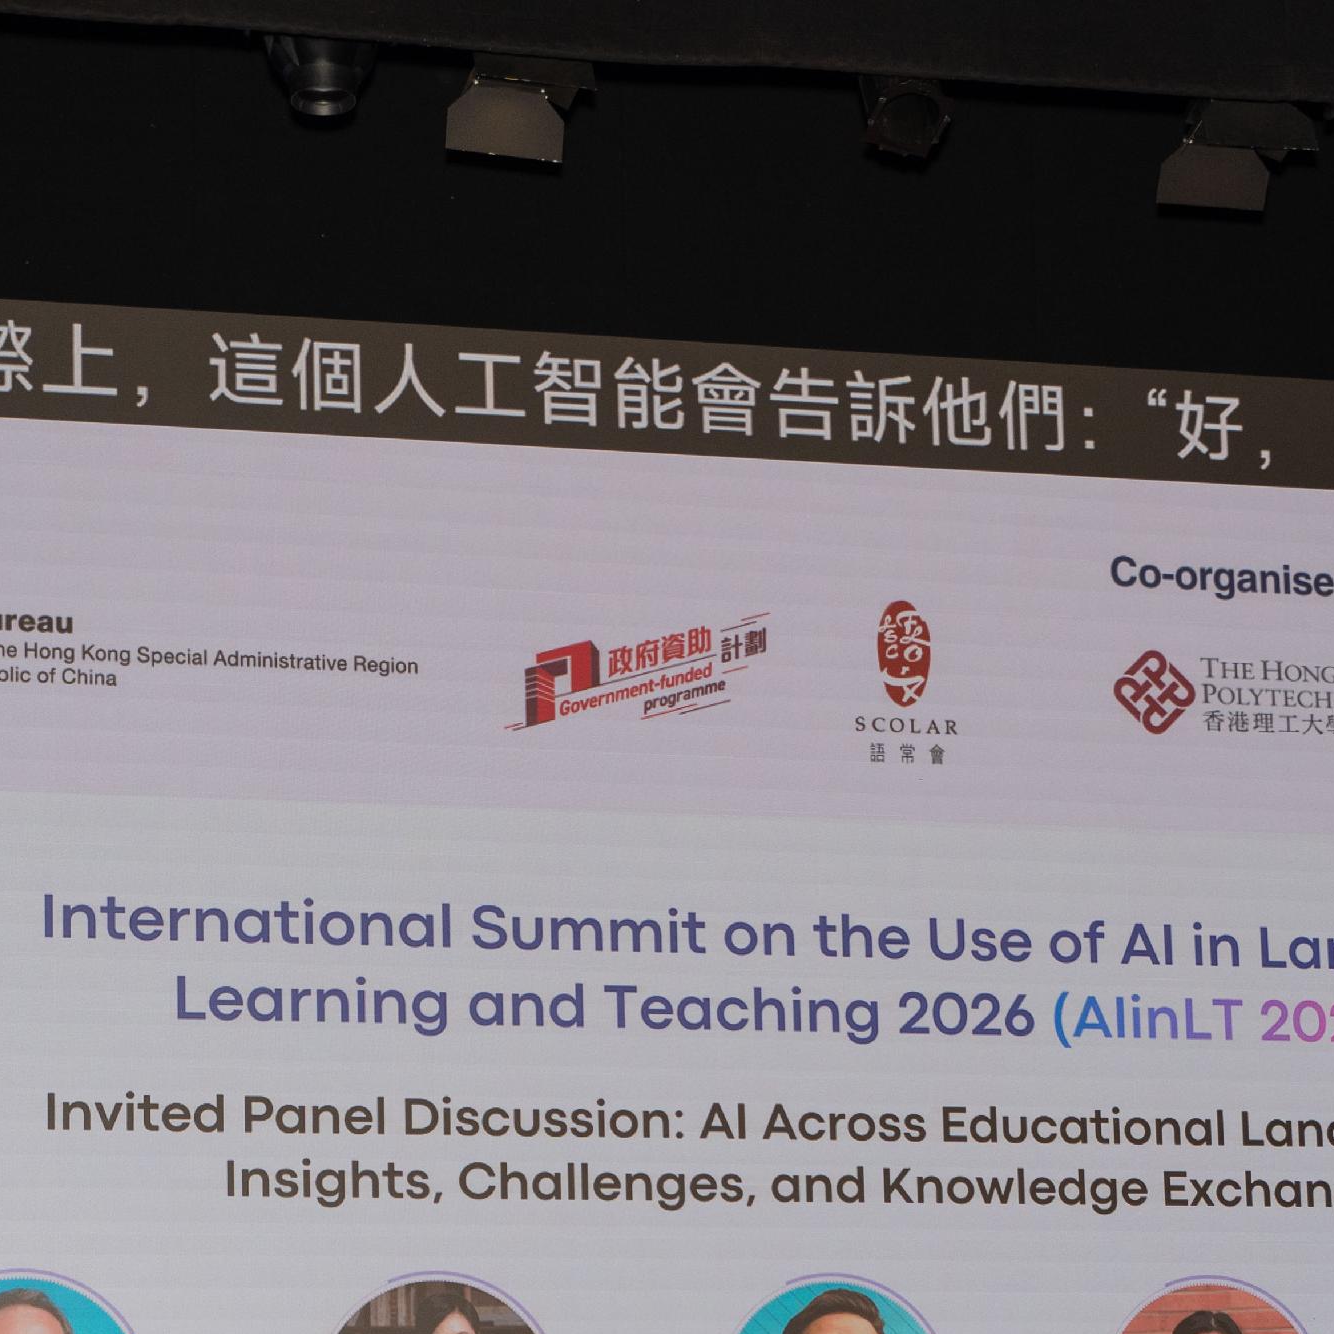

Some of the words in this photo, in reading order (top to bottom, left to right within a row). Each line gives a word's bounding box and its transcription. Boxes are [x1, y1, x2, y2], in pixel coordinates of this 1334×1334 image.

[24, 642, 75, 664] Hong
[82, 644, 130, 666] Kong
[137, 646, 207, 667] Special
[213, 650, 347, 671] Administrative
[354, 655, 418, 676] Region
[37, 668, 56, 683] of
[62, 668, 117, 686] China
[559, 662, 713, 717] Government-funded
[643, 680, 726, 715] programme
[855, 716, 957, 735] SCOLAR
[870, 743, 945, 764] 語常會
[44, 894, 451, 948] International
[473, 905, 706, 954] Summit
[724, 922, 795, 956] on
[813, 914, 910, 959] the
[929, 918, 1032, 962] Use
[1050, 920, 1105, 963] of
[1121, 923, 1173, 965] AI
[1193, 922, 1239, 967] in
[177, 976, 447, 1036] Learning
[469, 983, 584, 1028] and
[604, 985, 878, 1045] Teaching
[899, 992, 1035, 1036] 2026
[48, 1091, 224, 1133] Invited
[245, 1096, 384, 1134] Panel
[405, 1096, 683, 1139] Discussion:
[700, 1103, 746, 1139] AI
[763, 1104, 926, 1142] Across
[943, 1106, 1224, 1146] Educational
[227, 1158, 442, 1208] Insights,
[459, 1162, 755, 1211] Challenges,
[771, 1166, 864, 1203] and
[883, 1168, 1148, 1215] Knowledge
